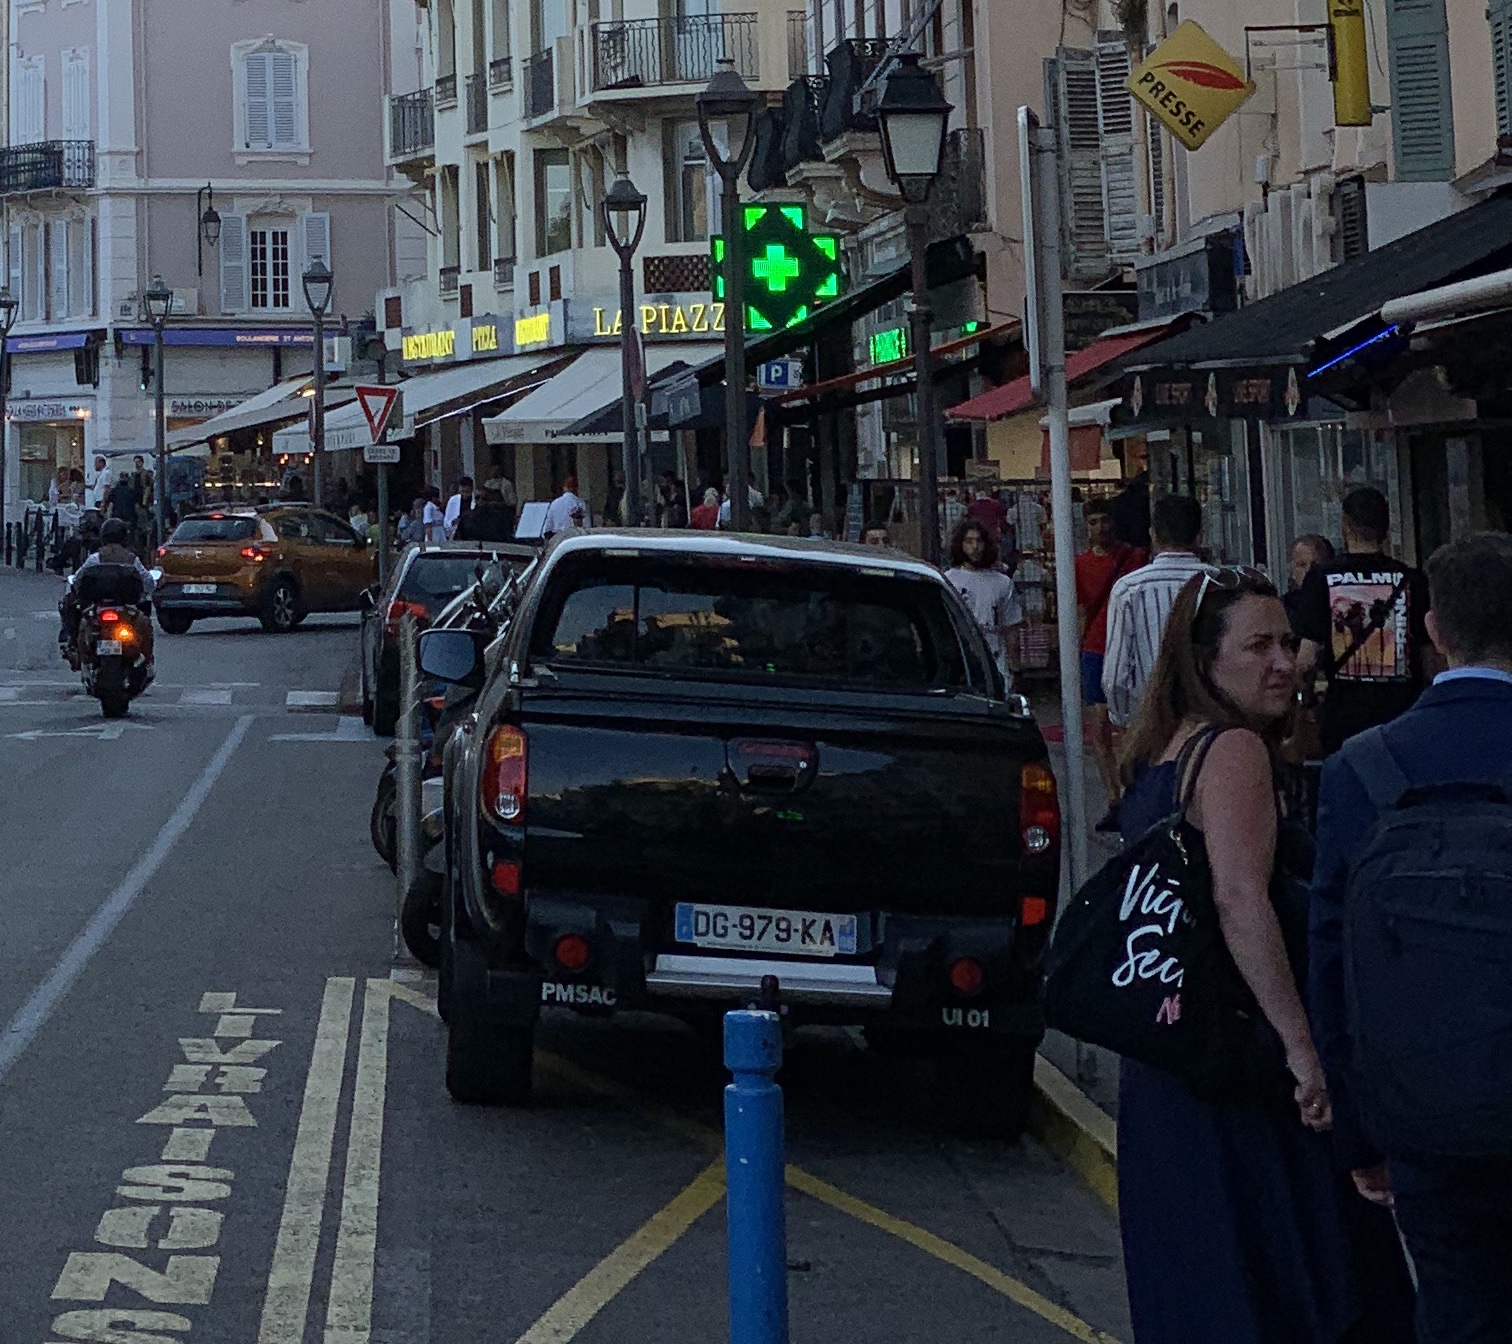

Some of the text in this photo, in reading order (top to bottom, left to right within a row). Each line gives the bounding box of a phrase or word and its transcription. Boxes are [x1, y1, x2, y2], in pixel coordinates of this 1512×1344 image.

[1137, 71, 1206, 139] PRESSE
[639, 302, 746, 335] PIAZZ
[1326, 571, 1393, 586] PALM
[694, 910, 836, 947] DG-979-KA
